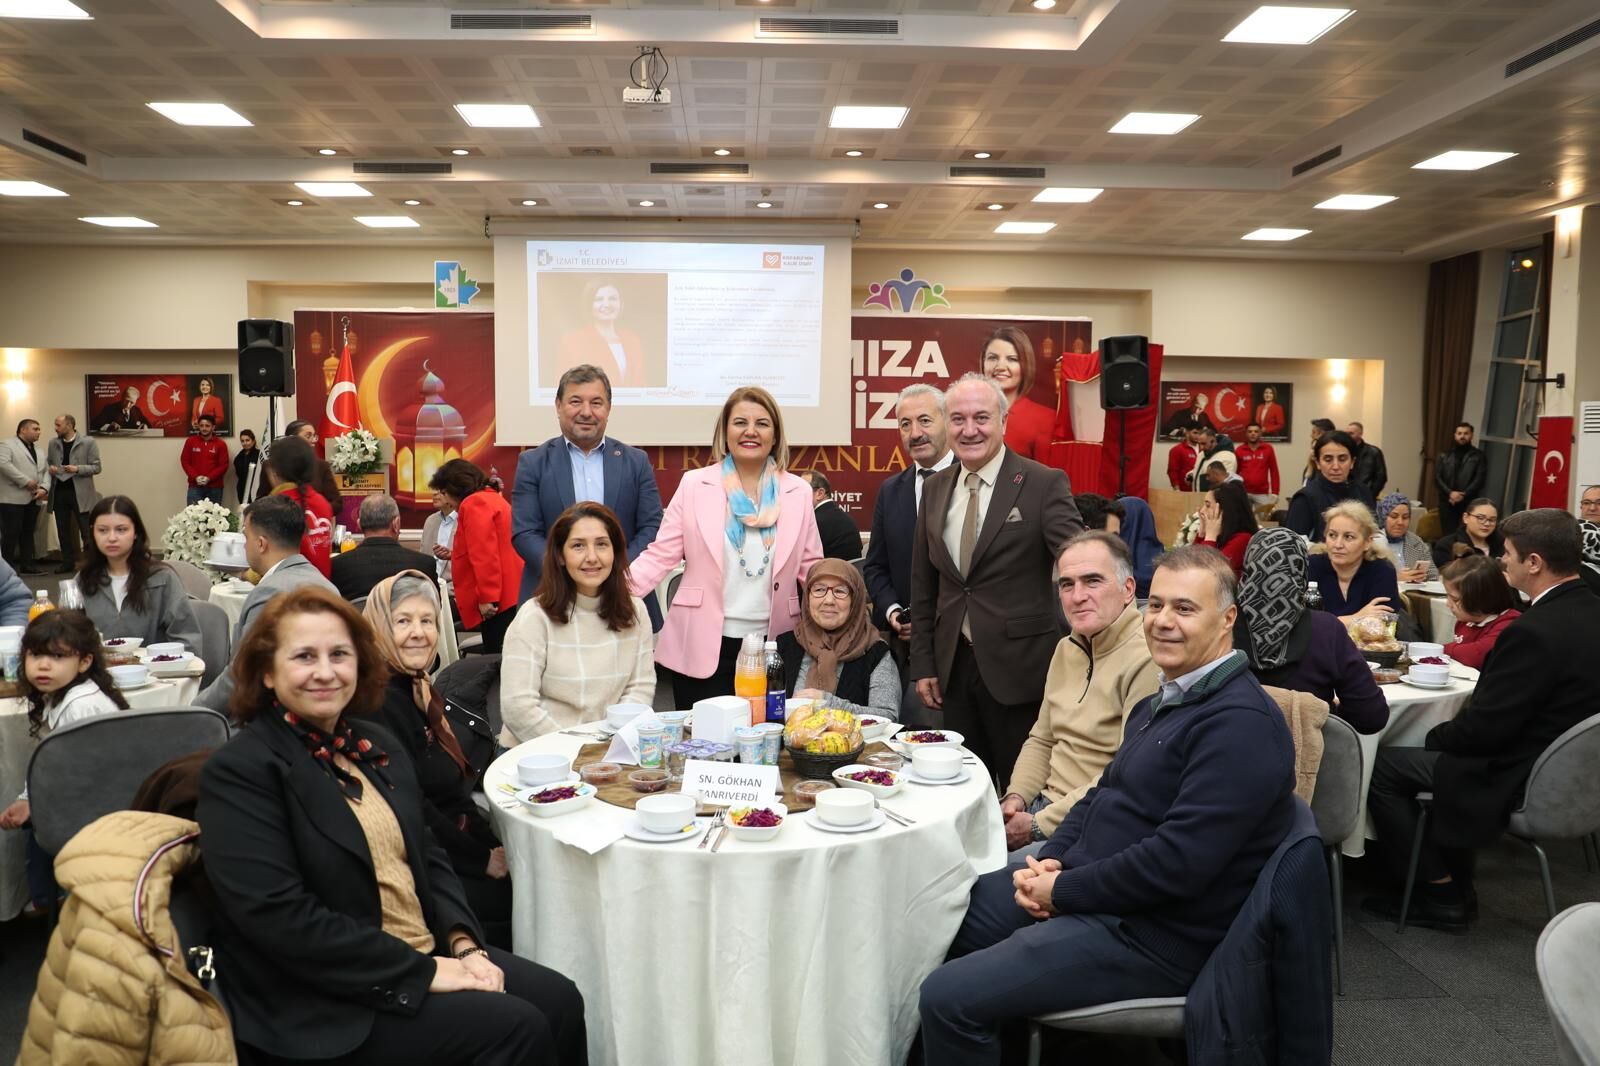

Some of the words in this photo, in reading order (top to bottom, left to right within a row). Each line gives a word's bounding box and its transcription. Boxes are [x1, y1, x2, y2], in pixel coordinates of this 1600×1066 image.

[581, 256, 628, 265] BELEDİYESİ
[699, 774, 714, 784] SN.
[717, 774, 763, 788] GÖKHAN
